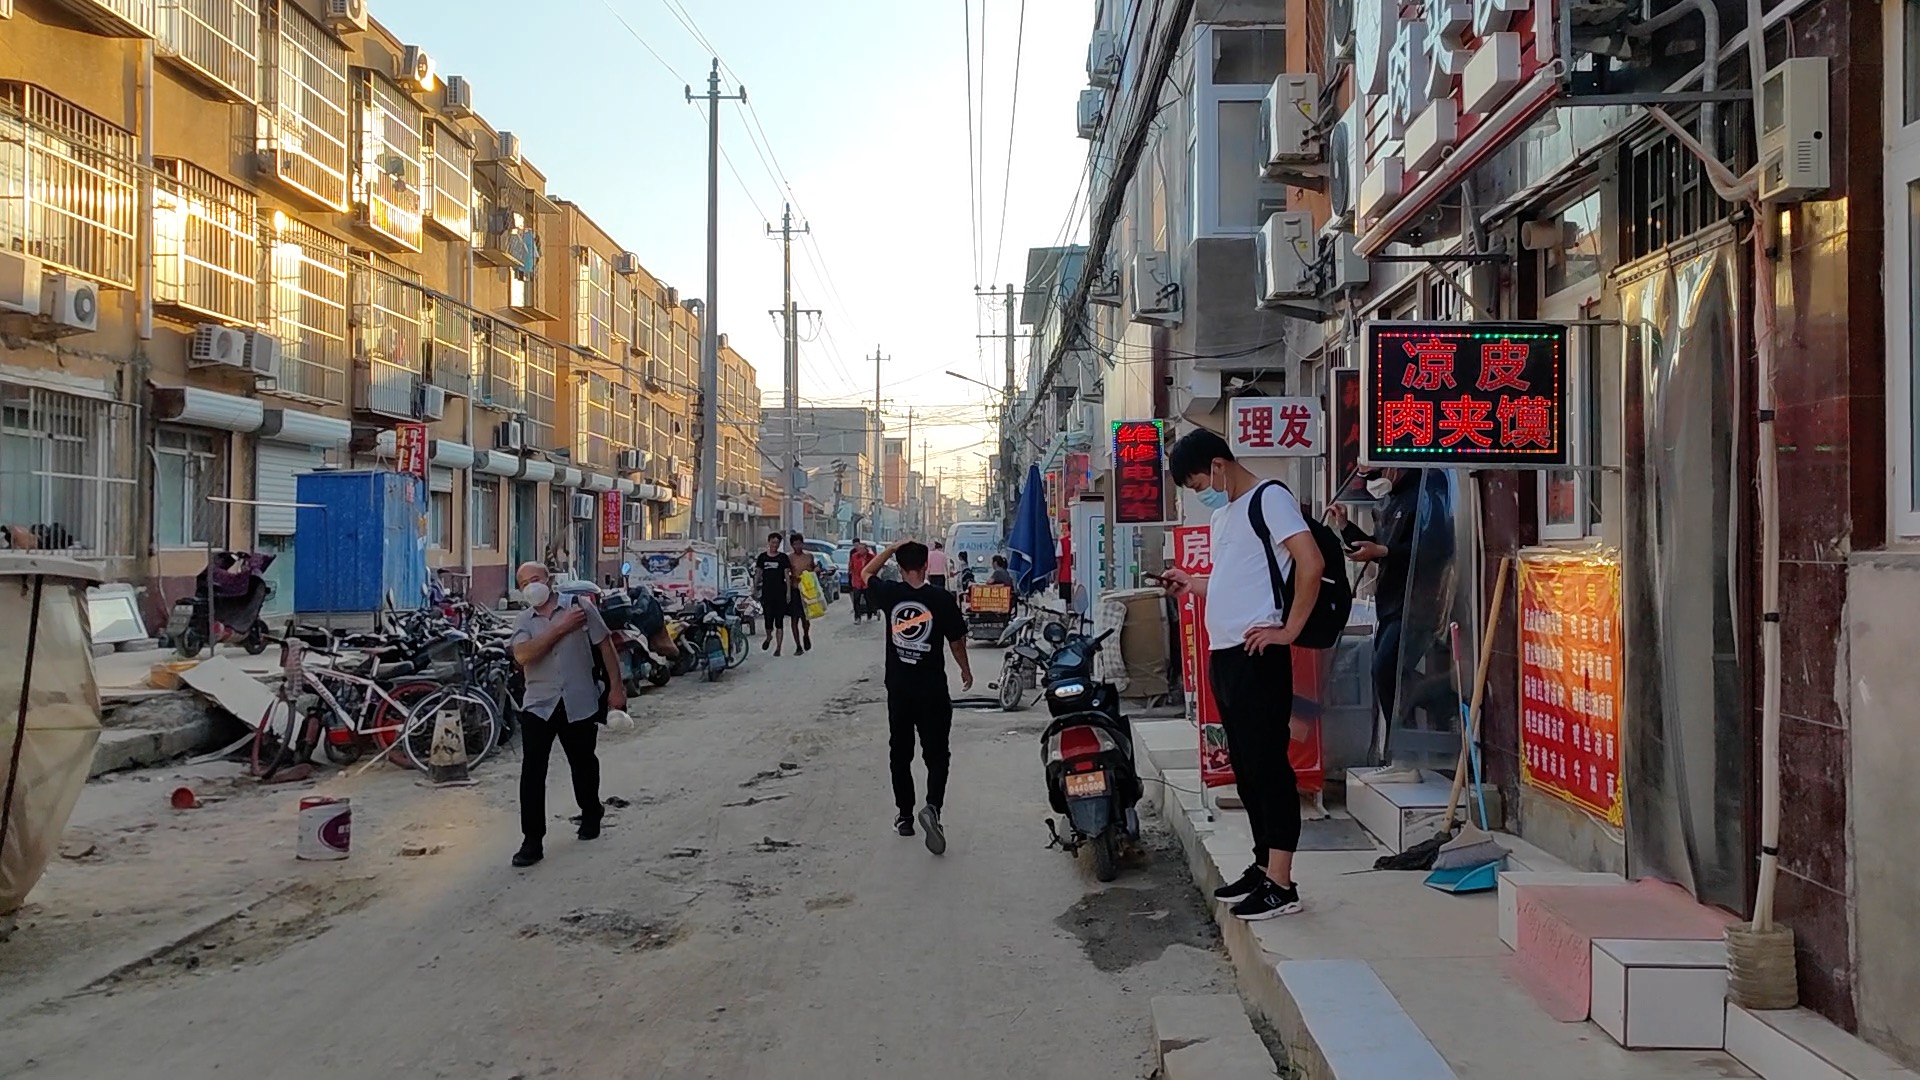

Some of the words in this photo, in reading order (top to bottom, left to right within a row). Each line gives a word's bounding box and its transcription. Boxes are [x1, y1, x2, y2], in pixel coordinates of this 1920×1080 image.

[1401, 338, 1531, 392] 凉皮
[1237, 404, 1313, 449] 理发
[1383, 393, 1552, 448] 肉夹馍
[1117, 424, 1159, 518] 维修电动车
